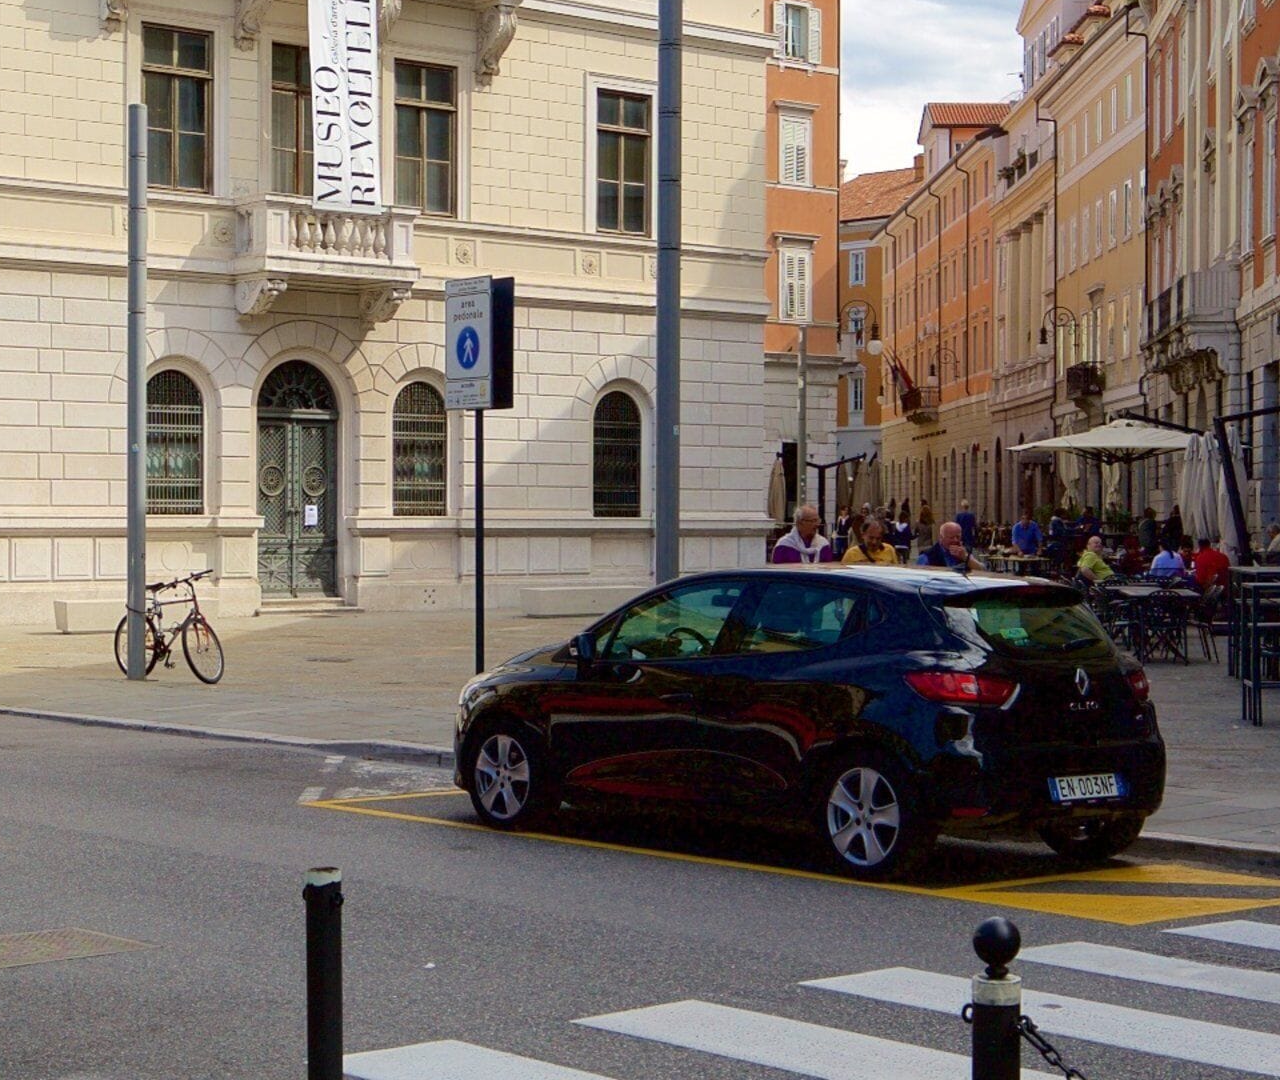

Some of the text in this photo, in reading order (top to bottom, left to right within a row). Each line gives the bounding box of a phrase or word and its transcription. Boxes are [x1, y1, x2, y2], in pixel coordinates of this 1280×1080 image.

[314, 66, 343, 204] MUSEO
[461, 300, 475, 309] area
[453, 308, 483, 322] pedonale
